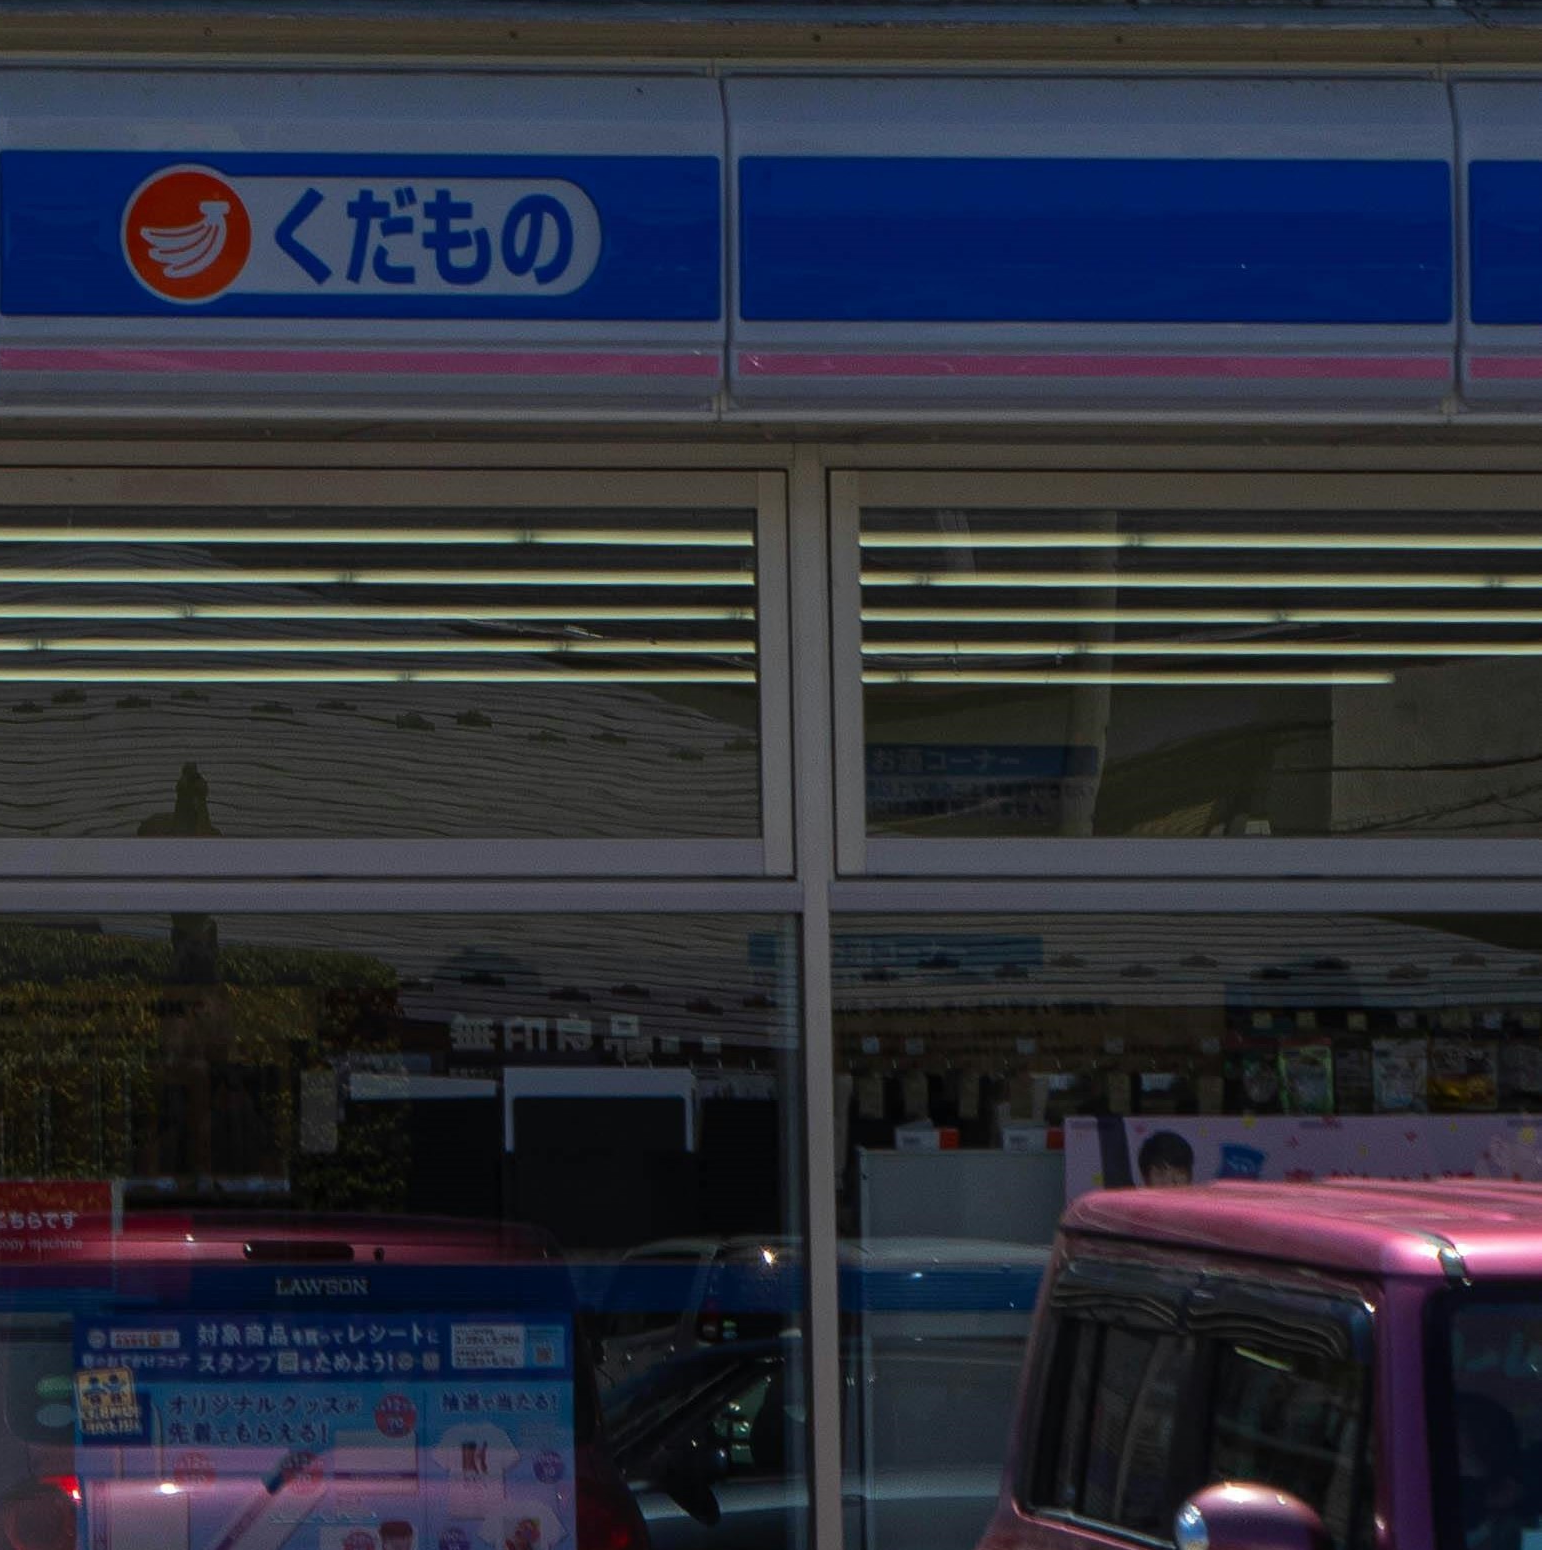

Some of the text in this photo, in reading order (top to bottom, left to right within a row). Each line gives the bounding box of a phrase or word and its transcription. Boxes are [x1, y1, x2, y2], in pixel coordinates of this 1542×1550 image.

[274, 186, 575, 284] くだもの
[274, 1276, 369, 1296] LAWSON
